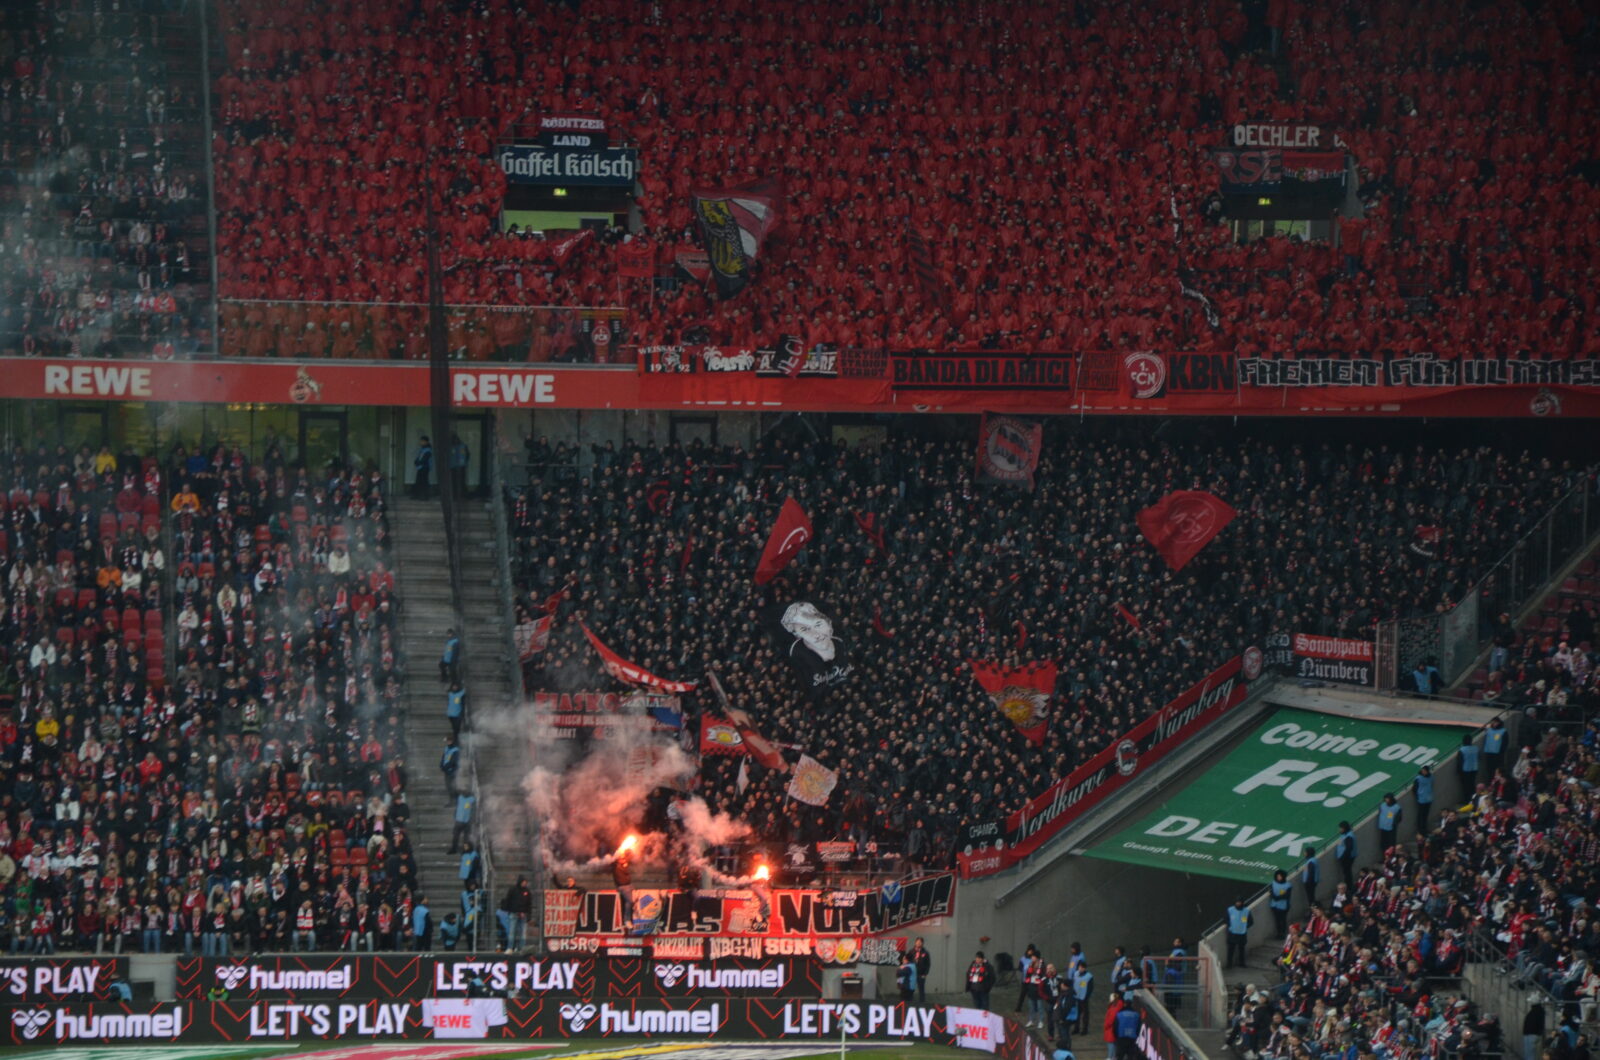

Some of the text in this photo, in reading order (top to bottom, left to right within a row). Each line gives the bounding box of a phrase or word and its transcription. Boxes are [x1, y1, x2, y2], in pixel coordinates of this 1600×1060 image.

[552, 135, 591, 147] LAND
[1234, 124, 1320, 147] OECHLER
[565, 152, 633, 180] Kölsch
[45, 365, 151, 396] REWE
[894, 359, 972, 383] BANDA
[976, 360, 1000, 384] DI
[1002, 361, 1070, 385] AMICI
[1169, 354, 1234, 390] KBN
[453, 373, 555, 403] REWE
[1298, 657, 1368, 684] Nürnberg
[1148, 676, 1235, 751] Nürnberg
[1260, 722, 1379, 757] Come
[1232, 758, 1391, 808] FC!
[1011, 768, 1106, 848] Nordkurve
[1144, 815, 1324, 858] DEVK
[0, 966, 100, 995] 'S PLAY
[249, 965, 351, 990] hummel
[515, 962, 580, 990] PLAY
[687, 964, 785, 988] hummel
[55, 1006, 182, 1039] hummel
[250, 1004, 410, 1035] LET'S PLAY
[600, 1003, 720, 1033] hummel
[783, 1003, 935, 1037] LET'S PLAY
